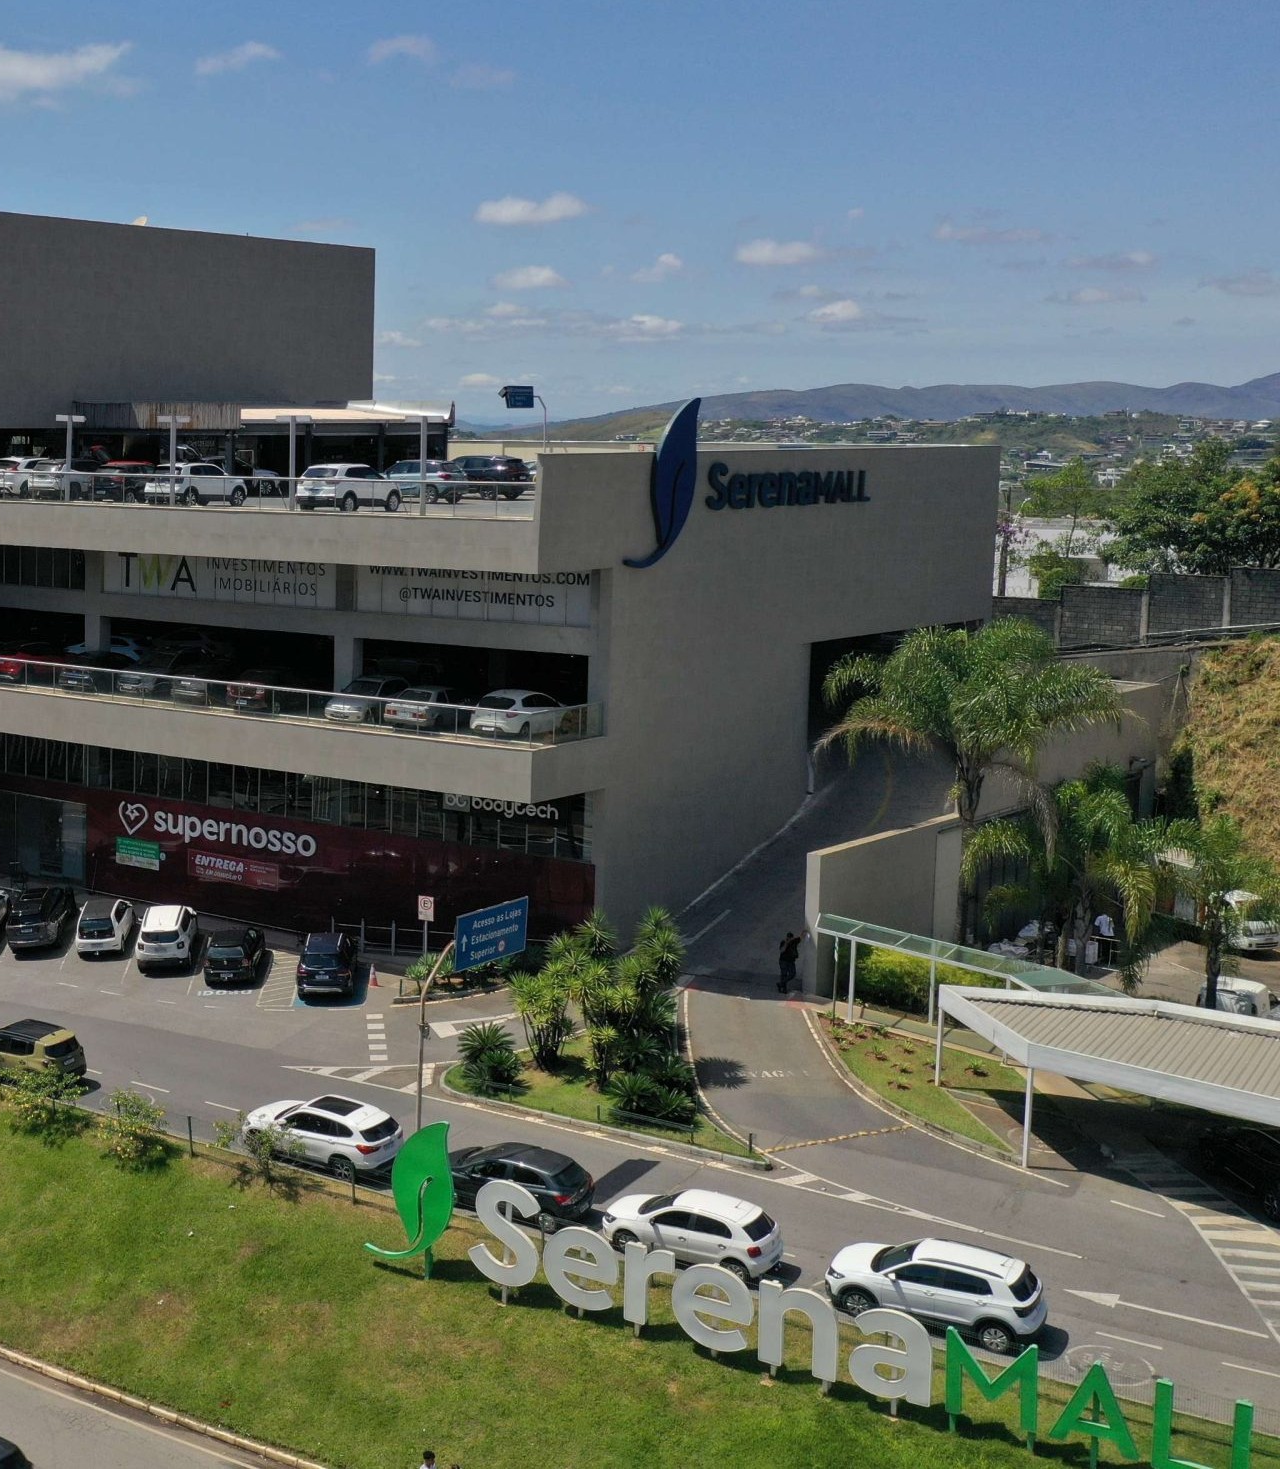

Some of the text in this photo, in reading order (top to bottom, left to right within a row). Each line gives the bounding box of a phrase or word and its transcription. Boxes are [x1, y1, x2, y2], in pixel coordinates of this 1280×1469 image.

[119, 552, 196, 592] TWA
[206, 556, 326, 577] INVESTIMENTOS
[214, 576, 318, 596] IMOBILIÁRIOS
[399, 587, 555, 608] @TWAINVESTIMENTOS
[472, 797, 559, 820] bodytech
[154, 811, 317, 857] supernosso
[195, 854, 244, 873] ENTREGA
[472, 917, 495, 930] Acesso
[504, 908, 522, 921] Lojas
[471, 923, 519, 945] Estacionamento
[469, 945, 496, 961] Superior
